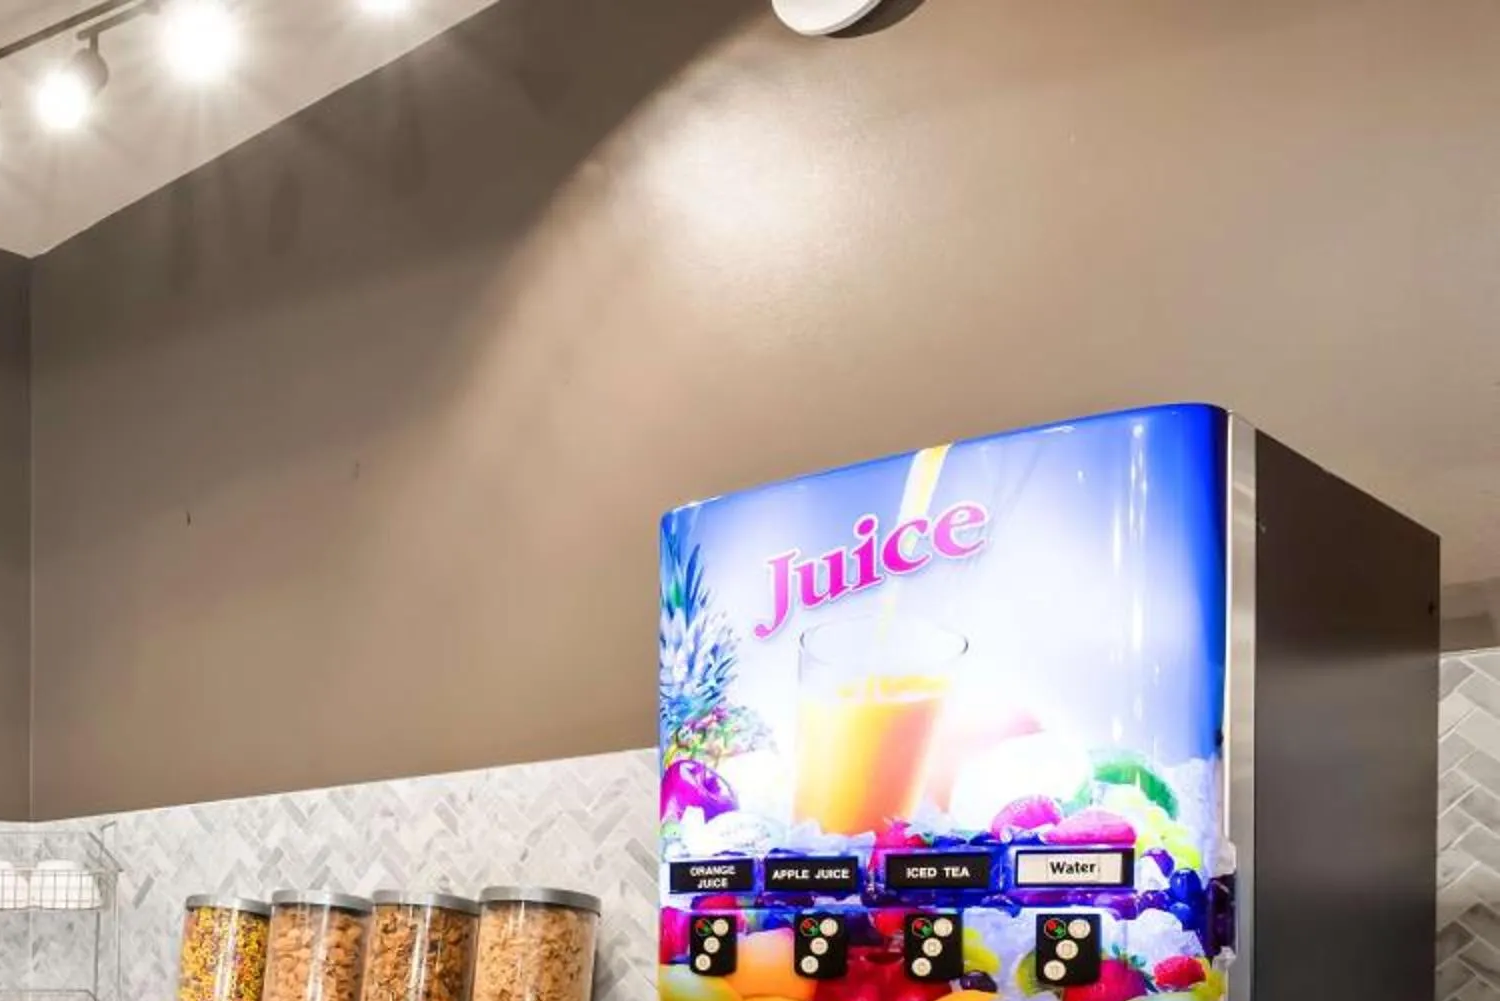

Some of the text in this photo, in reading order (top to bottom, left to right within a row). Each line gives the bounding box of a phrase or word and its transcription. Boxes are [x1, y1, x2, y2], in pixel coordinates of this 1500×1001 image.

[753, 501, 987, 640] Juice
[689, 865, 736, 877] ORANGE
[906, 866, 971, 879] ICED TEA
[1049, 860, 1096, 875] Water
[772, 868, 850, 880] APPLE JUICE
[697, 878, 729, 889] JUICE
